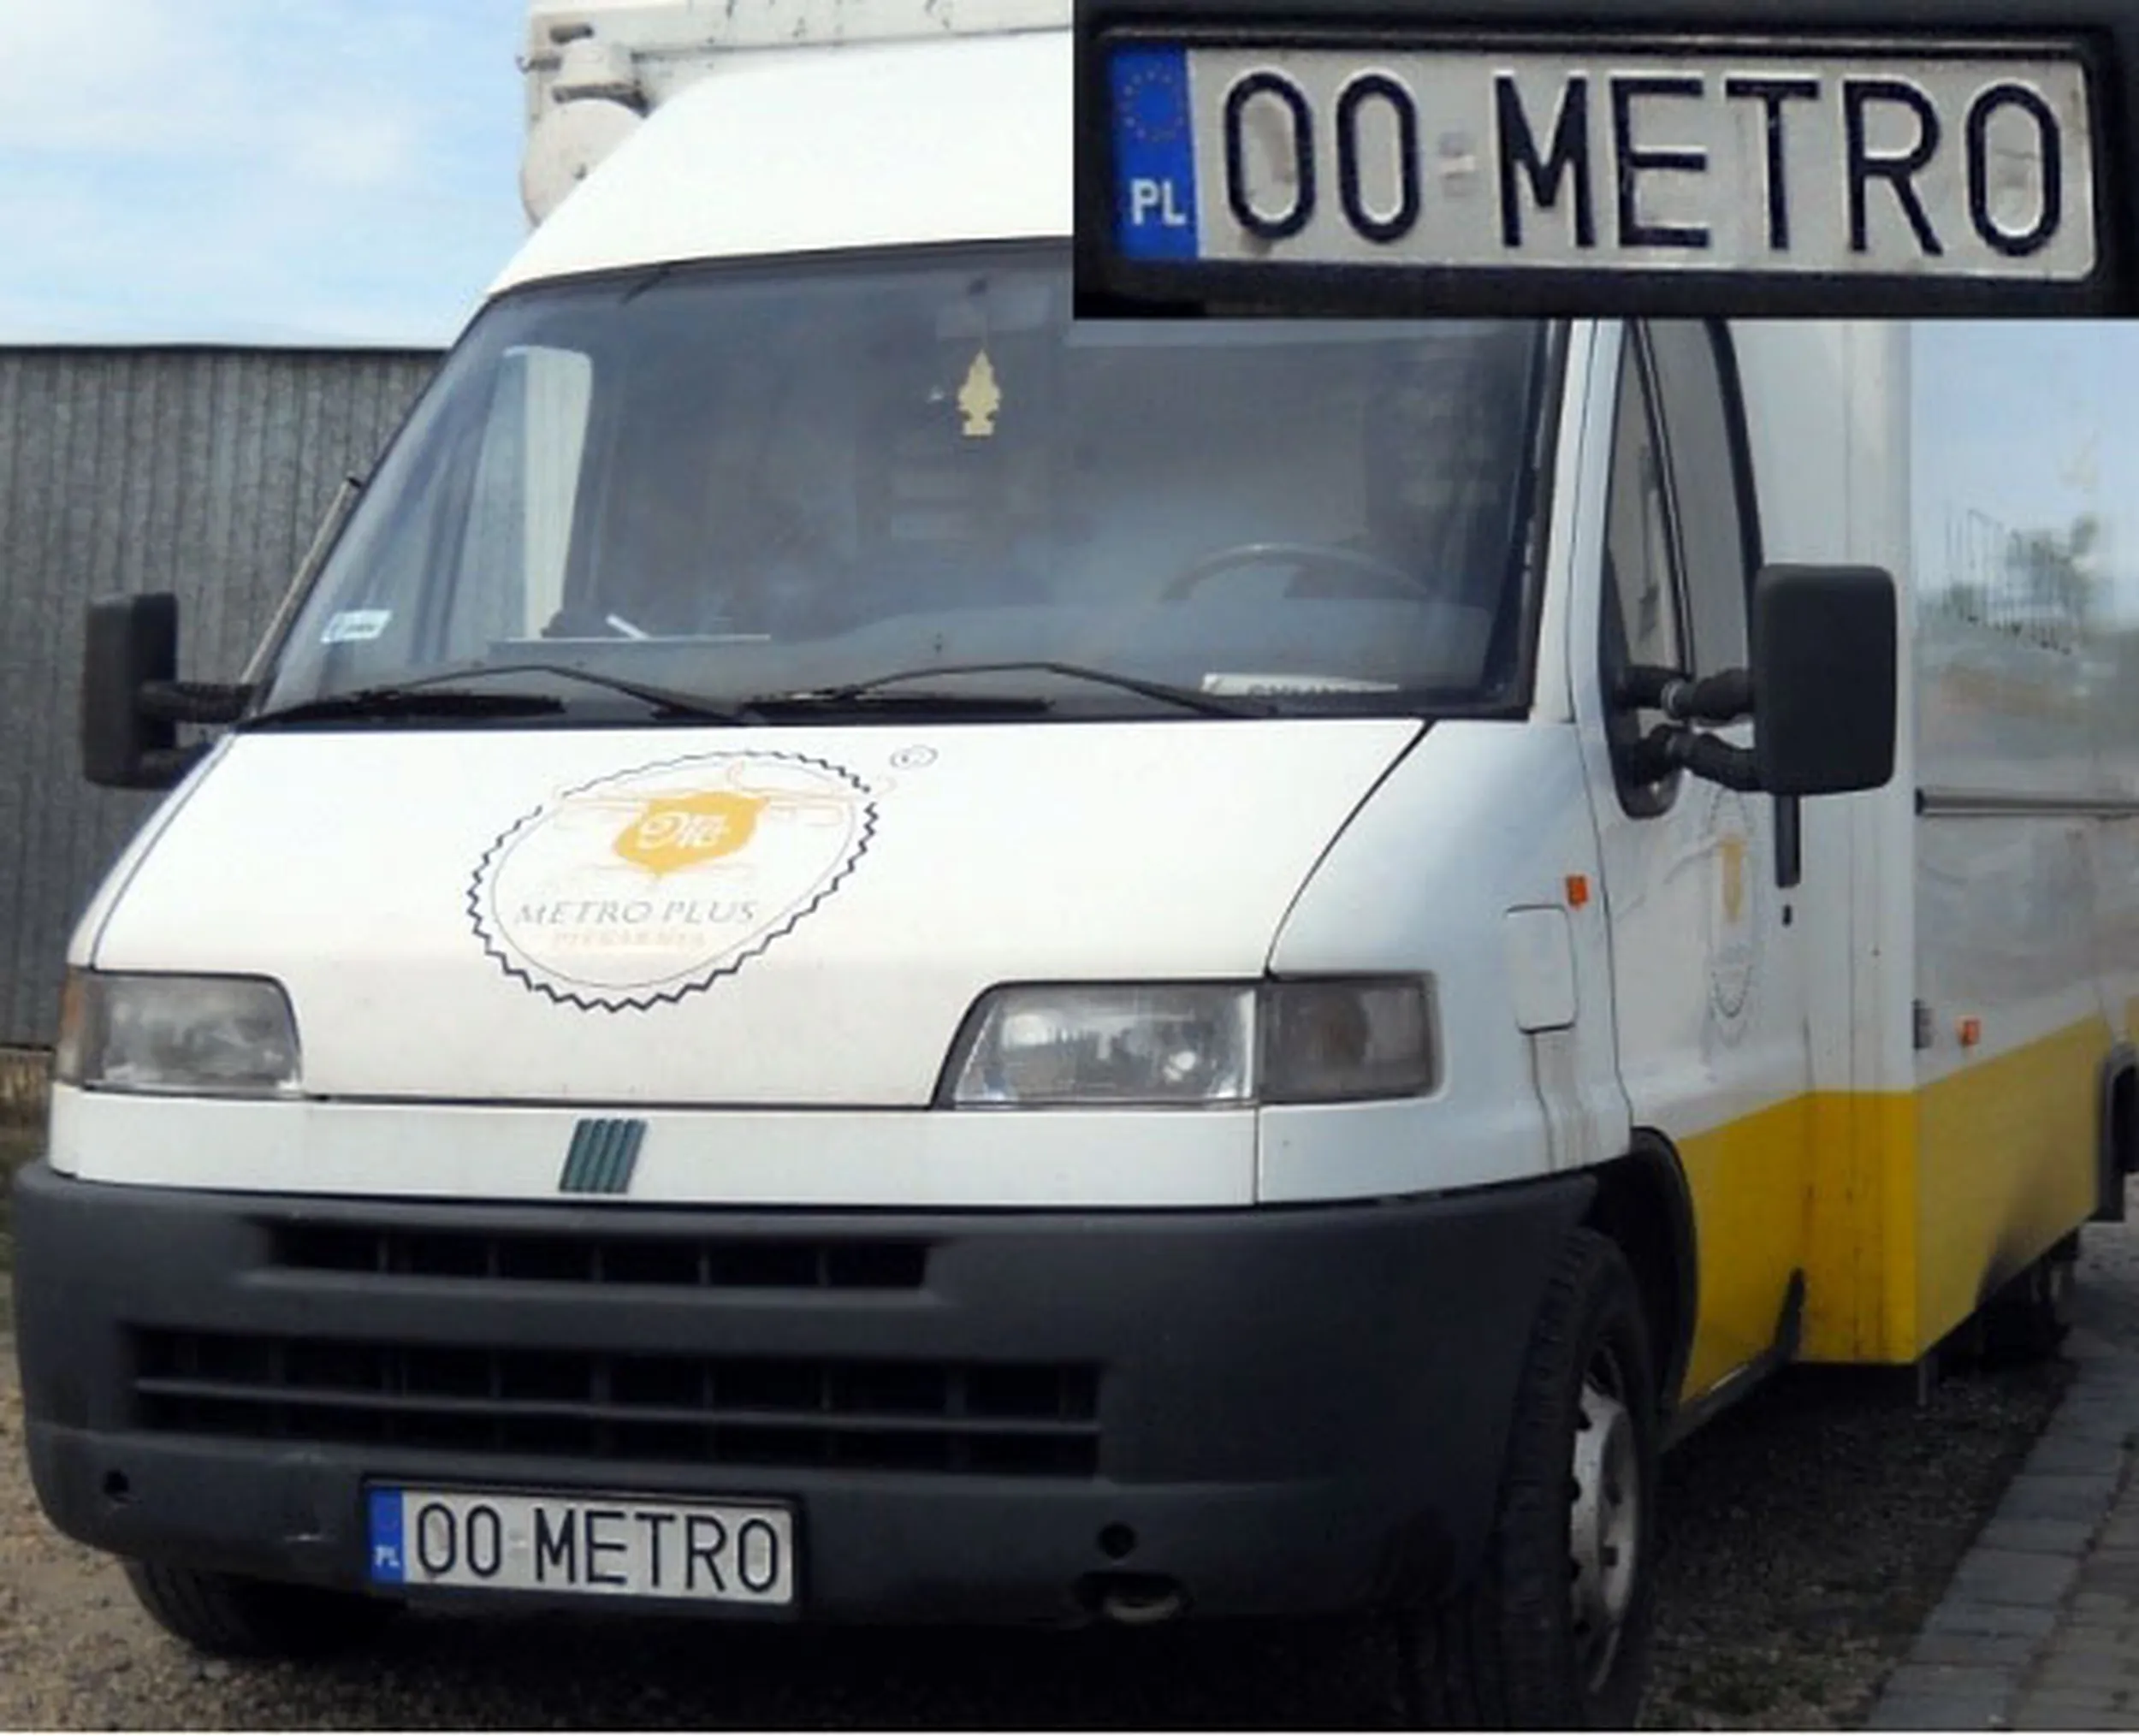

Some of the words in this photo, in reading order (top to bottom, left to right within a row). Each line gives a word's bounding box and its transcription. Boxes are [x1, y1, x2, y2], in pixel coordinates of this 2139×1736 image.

[1494, 75, 2061, 256] METRO
[1133, 181, 1186, 227] PL
[514, 901, 654, 925] METRO
[662, 900, 759, 925] PLUS
[534, 1508, 779, 1592] METRO
